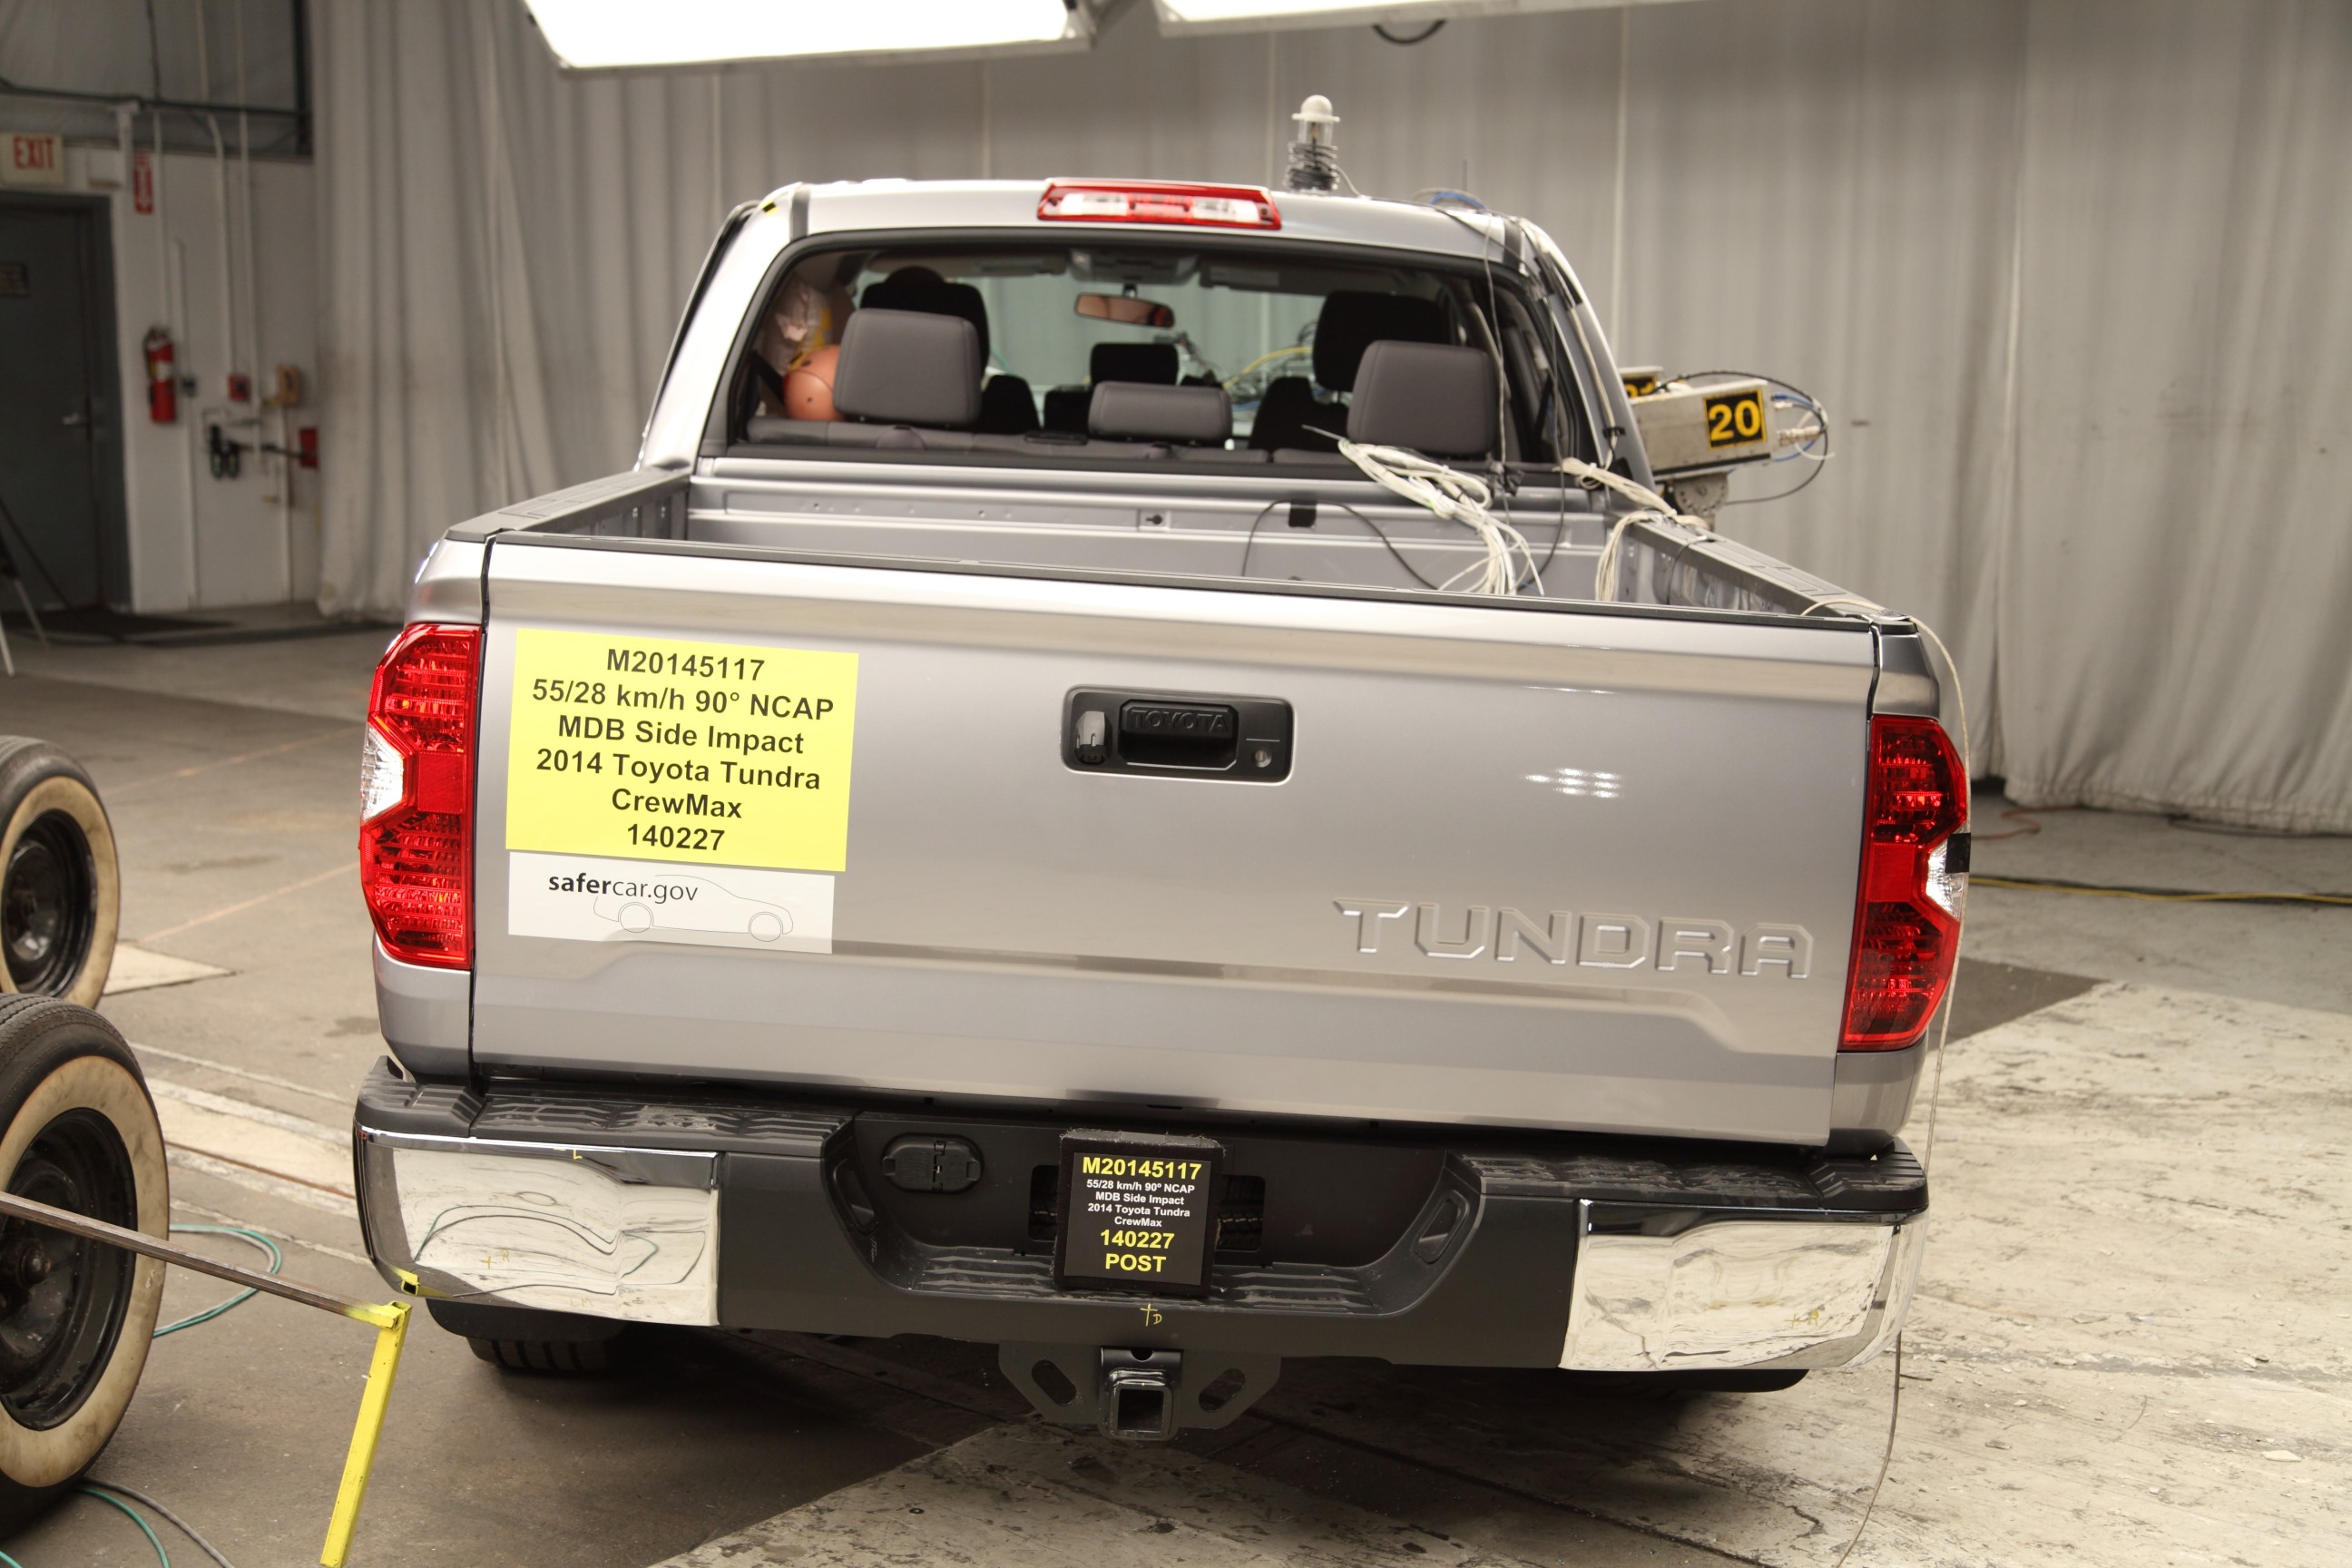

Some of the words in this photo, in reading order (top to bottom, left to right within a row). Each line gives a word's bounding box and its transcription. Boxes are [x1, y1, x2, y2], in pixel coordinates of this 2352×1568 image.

[13, 136, 54, 171] EXIT
[1708, 399, 1760, 442] 20
[607, 648, 765, 681] M20145117
[533, 678, 606, 705] 55/28
[617, 684, 684, 710] km/h
[750, 693, 834, 720] NCAP
[558, 714, 625, 740] MDB
[635, 720, 698, 747] Side
[708, 725, 804, 756] Impact
[1131, 709, 1229, 733] TOYOTA
[536, 748, 603, 774] 2014
[612, 753, 710, 784] Toyota
[720, 760, 820, 789] Tundra
[612, 788, 742, 818] CrewMax
[627, 823, 725, 851] 140227
[548, 872, 698, 905] safercar.gov
[1334, 897, 1813, 979] TUNDRA
[1083, 1156, 1202, 1181] M20145117
[1086, 1179, 1114, 1190] 55/28
[1116, 1181, 1142, 1191] km/h
[1163, 1183, 1195, 1194] NCAP
[1095, 1191, 1121, 1201] MDB
[1123, 1192, 1147, 1203] Side
[1149, 1194, 1185, 1206] Impact
[1087, 1202, 1113, 1213] 2014
[1115, 1204, 1152, 1216] Toyota
[1153, 1206, 1191, 1218] Tundra
[1113, 1215, 1162, 1228] CrewMax
[1100, 1229, 1175, 1250] 140227
[1104, 1252, 1167, 1273] POST
